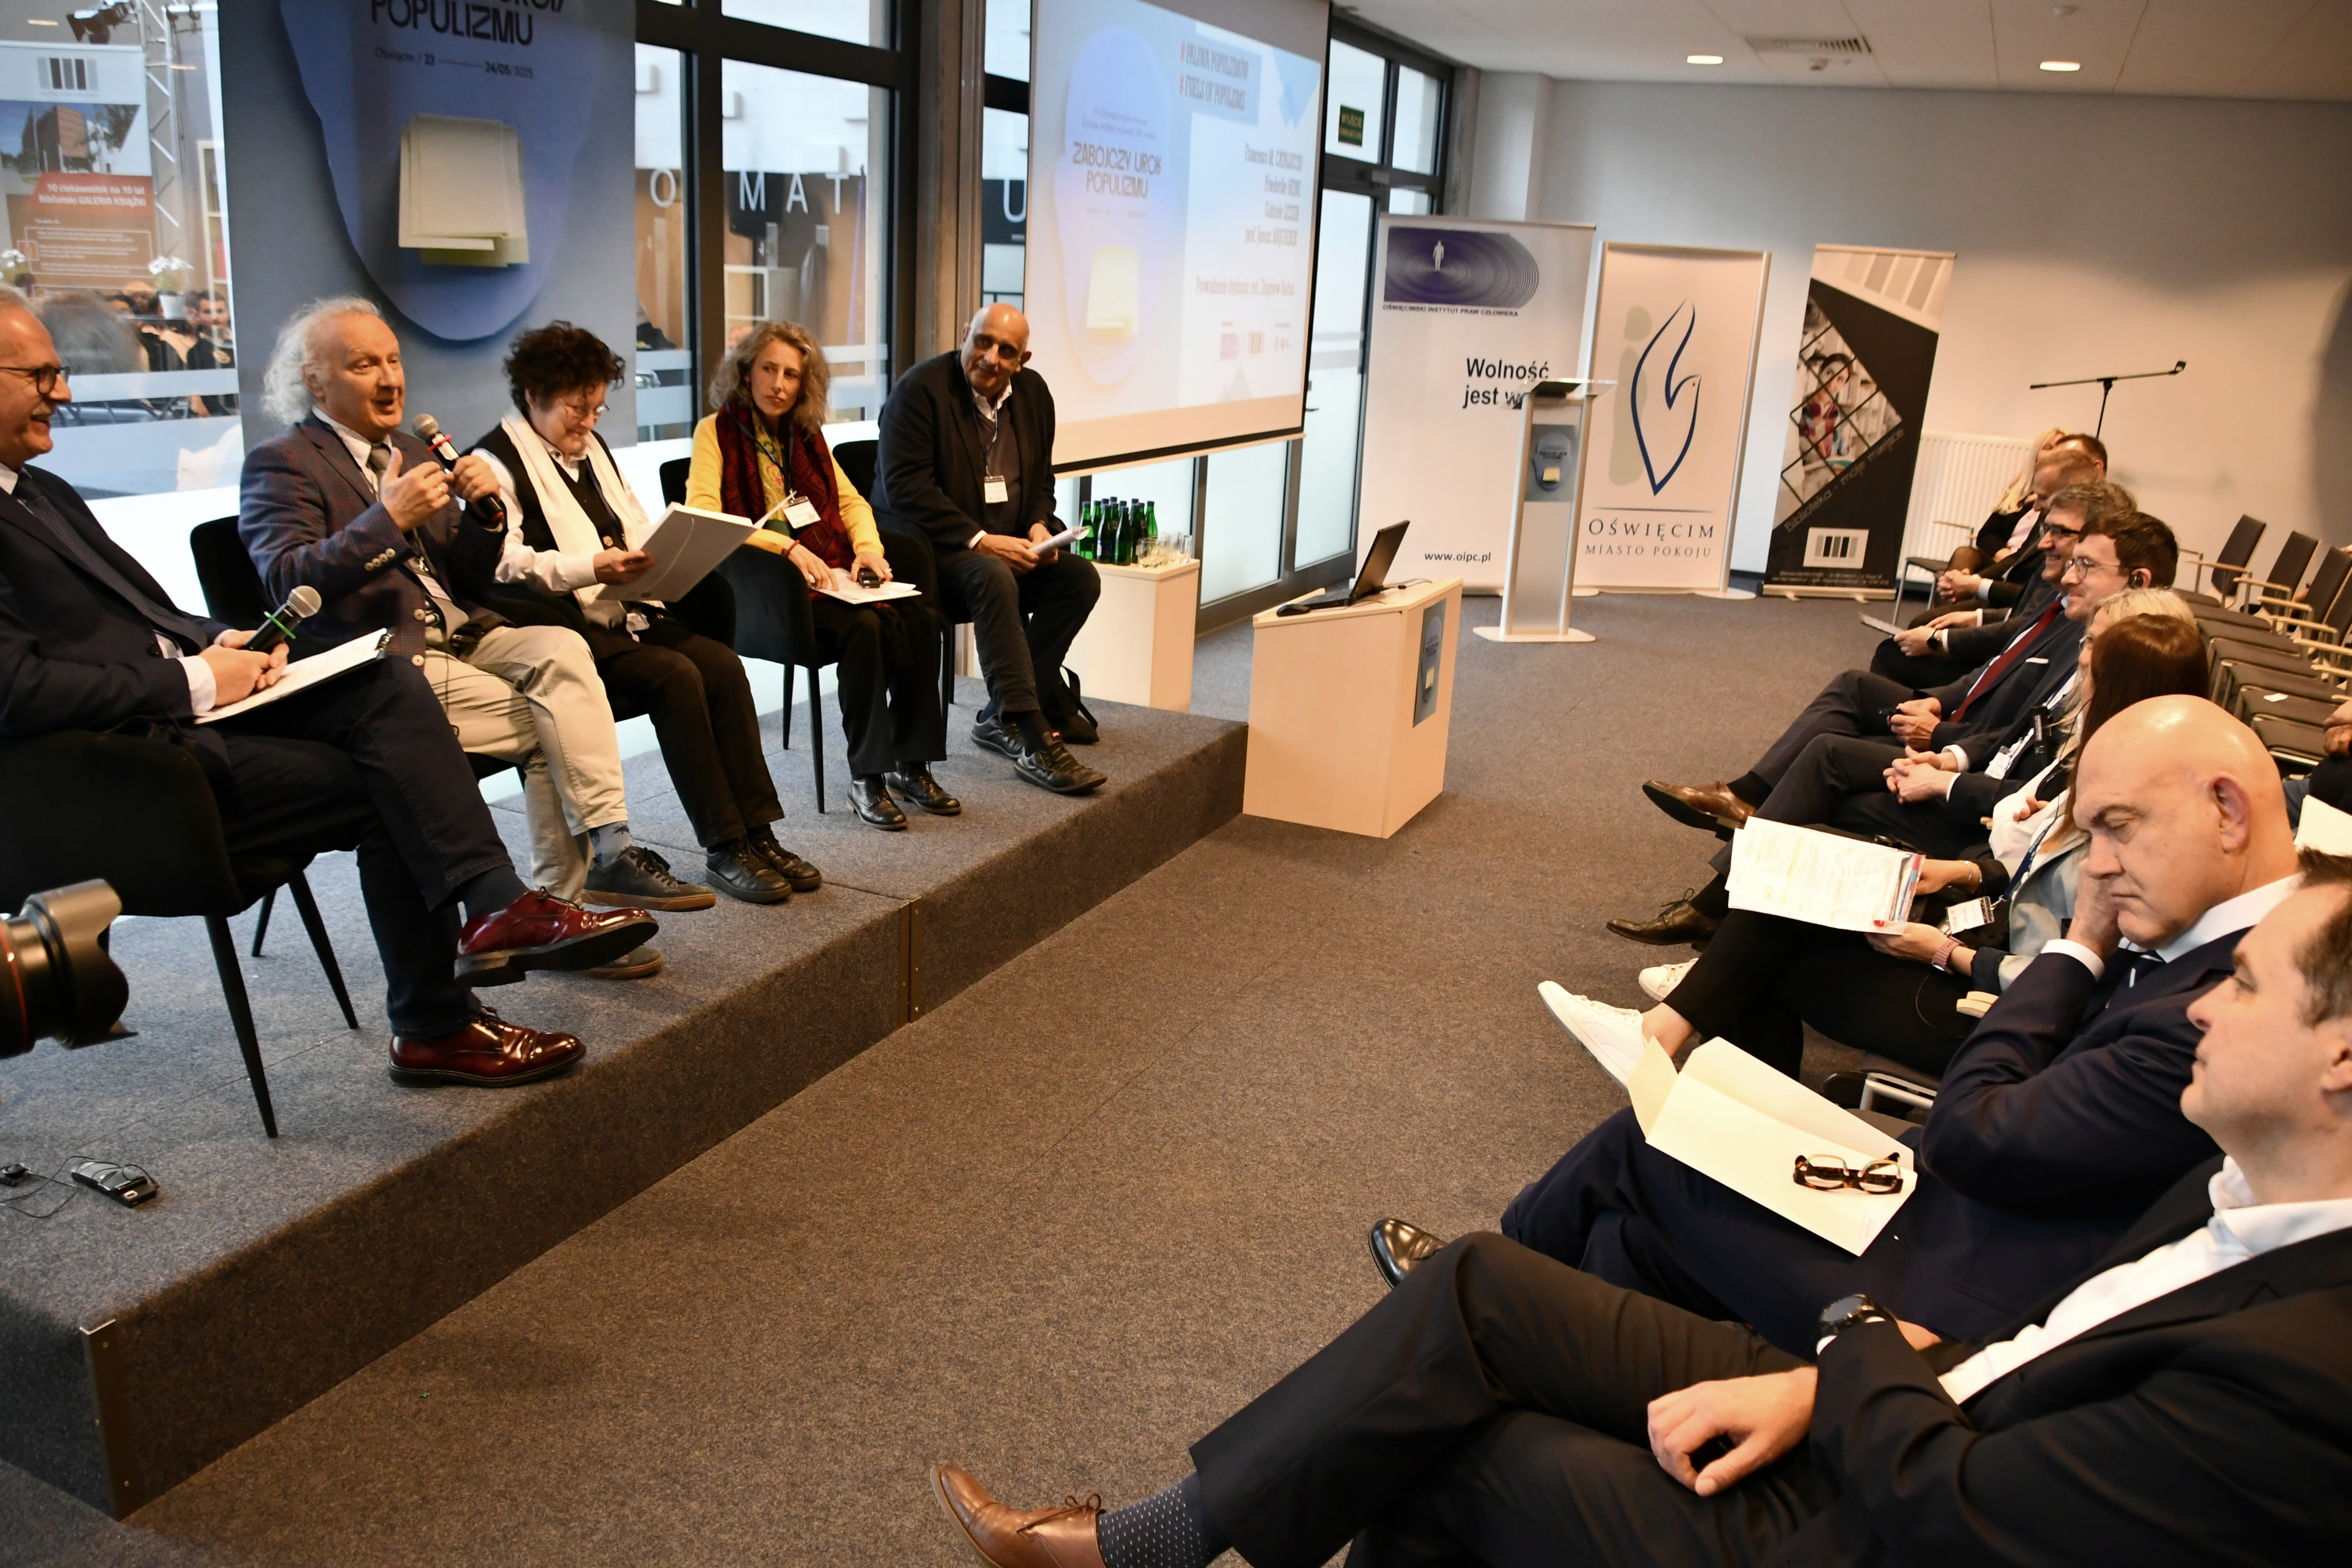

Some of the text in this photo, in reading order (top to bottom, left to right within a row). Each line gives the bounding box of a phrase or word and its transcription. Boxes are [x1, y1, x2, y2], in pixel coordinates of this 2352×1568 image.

[371, 0, 533, 46] POPULIZMU
[1135, 152, 1162, 176] UROK
[1087, 170, 1149, 199] POPULIZMU
[1383, 304, 1426, 313] OŚWIĘCIMSKI
[1428, 306, 1458, 314] INSTYTUT
[1466, 358, 1549, 381] Wolność
[1462, 385, 1499, 409] jest
[1784, 488, 1833, 533] Biblioteka
[1840, 461, 1866, 486] moje
[1867, 428, 1905, 463] miejsce
[1588, 518, 1714, 542] OŚWIĘCIM
[1424, 551, 1491, 564] www.oipc.pl
[1585, 544, 1711, 560] MIASTO POKOJU
